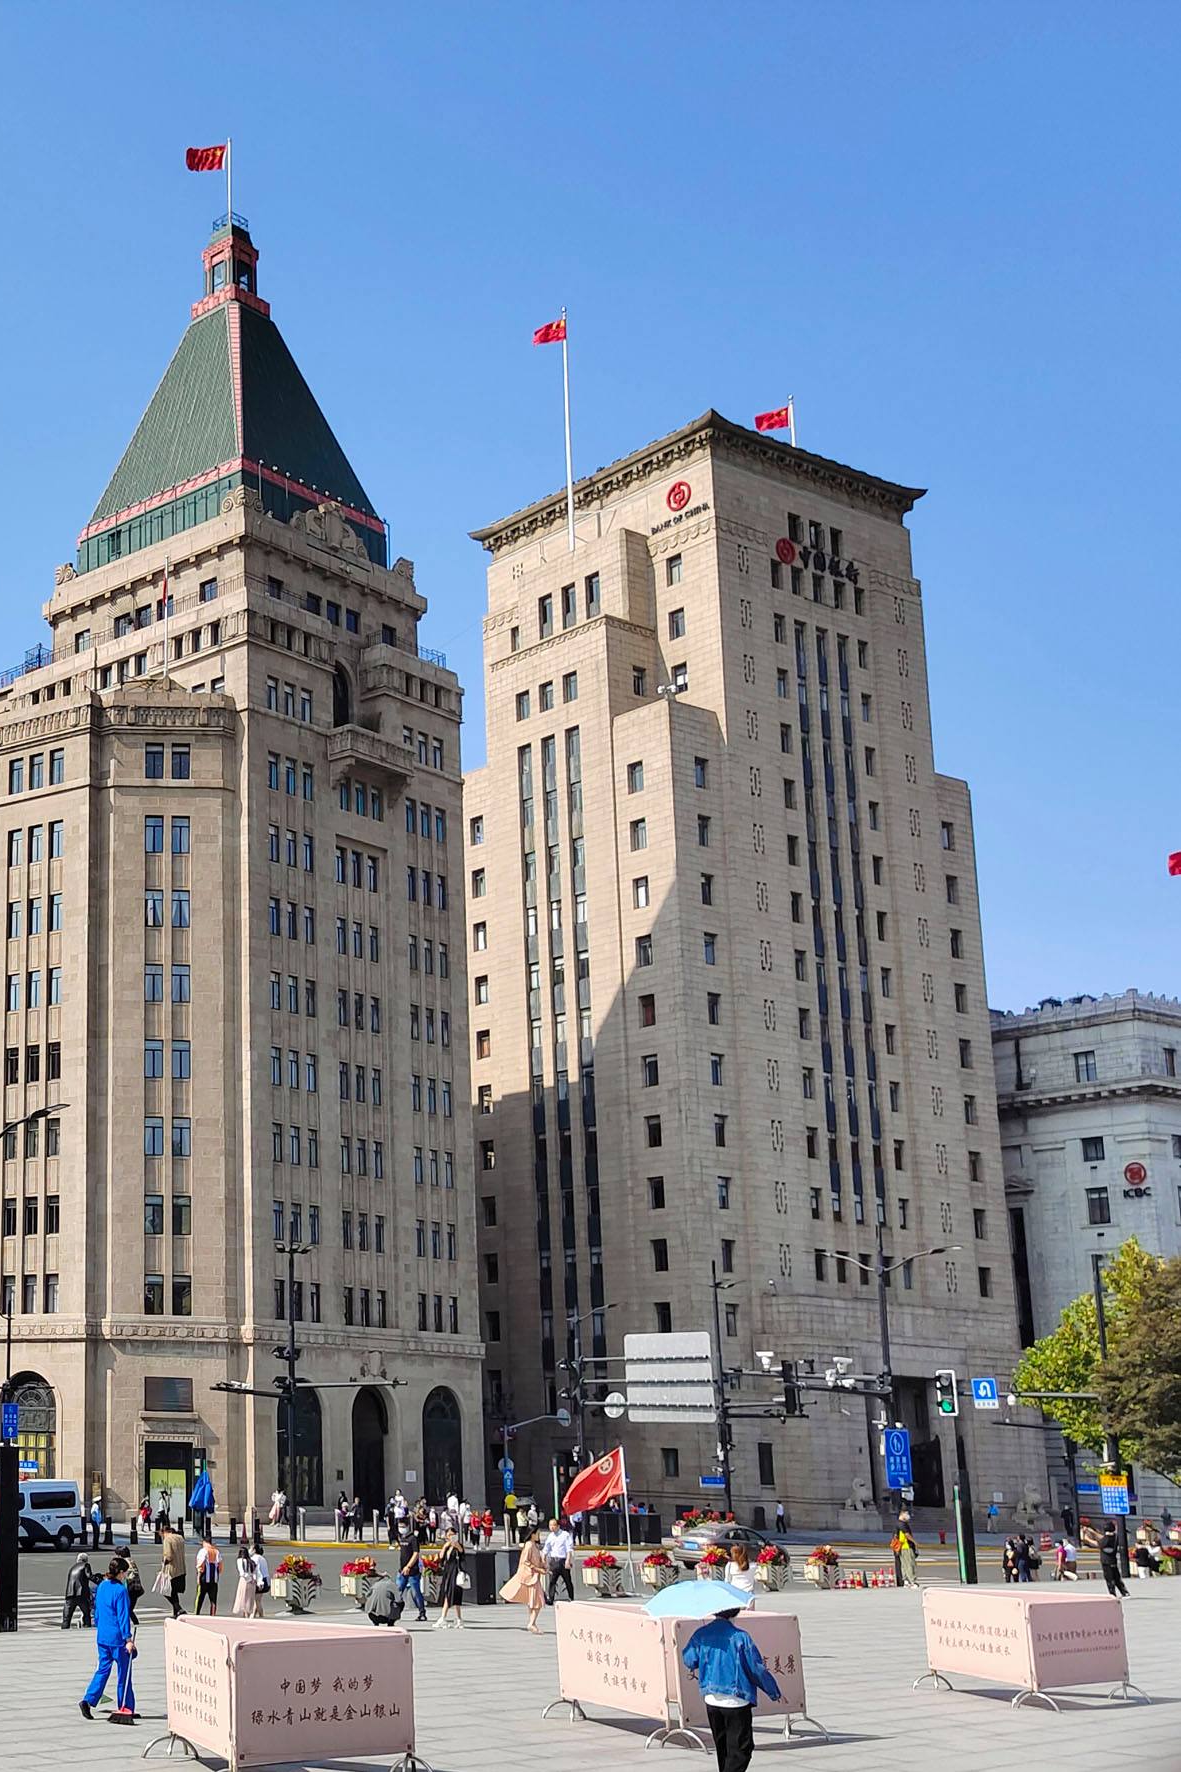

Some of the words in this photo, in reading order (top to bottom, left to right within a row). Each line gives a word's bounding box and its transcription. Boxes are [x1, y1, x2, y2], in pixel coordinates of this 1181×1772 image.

[1122, 1186, 1153, 1199] ICBC
[570, 1627, 613, 1645] 人民有信仰
[280, 1676, 322, 1696] 中国梦
[332, 1674, 374, 1693] 我的梦
[603, 1672, 647, 1694] 民族有希望
[251, 1702, 401, 1726] 绿水青山就是金山银山
